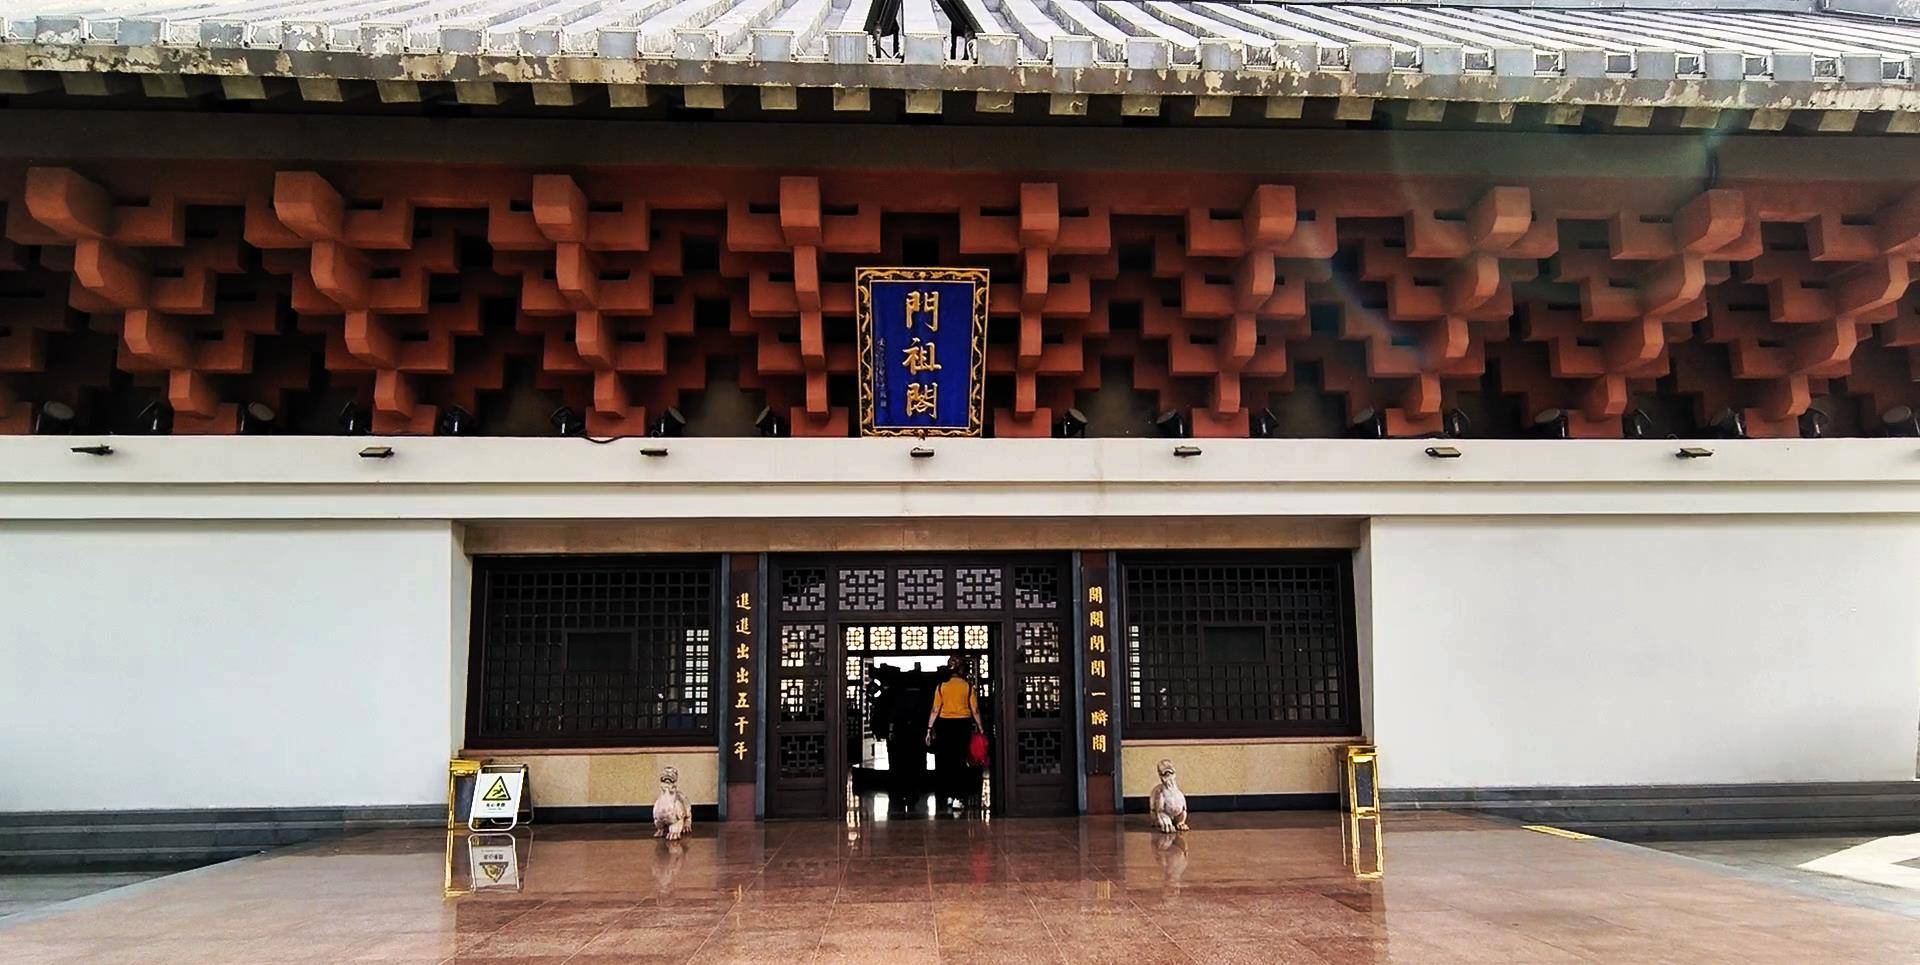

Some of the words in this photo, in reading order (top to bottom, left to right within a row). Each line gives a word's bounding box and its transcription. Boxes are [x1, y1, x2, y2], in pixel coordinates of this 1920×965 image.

[902, 290, 942, 419] 門祖閣
[734, 592, 751, 760] 進進出出五千年
